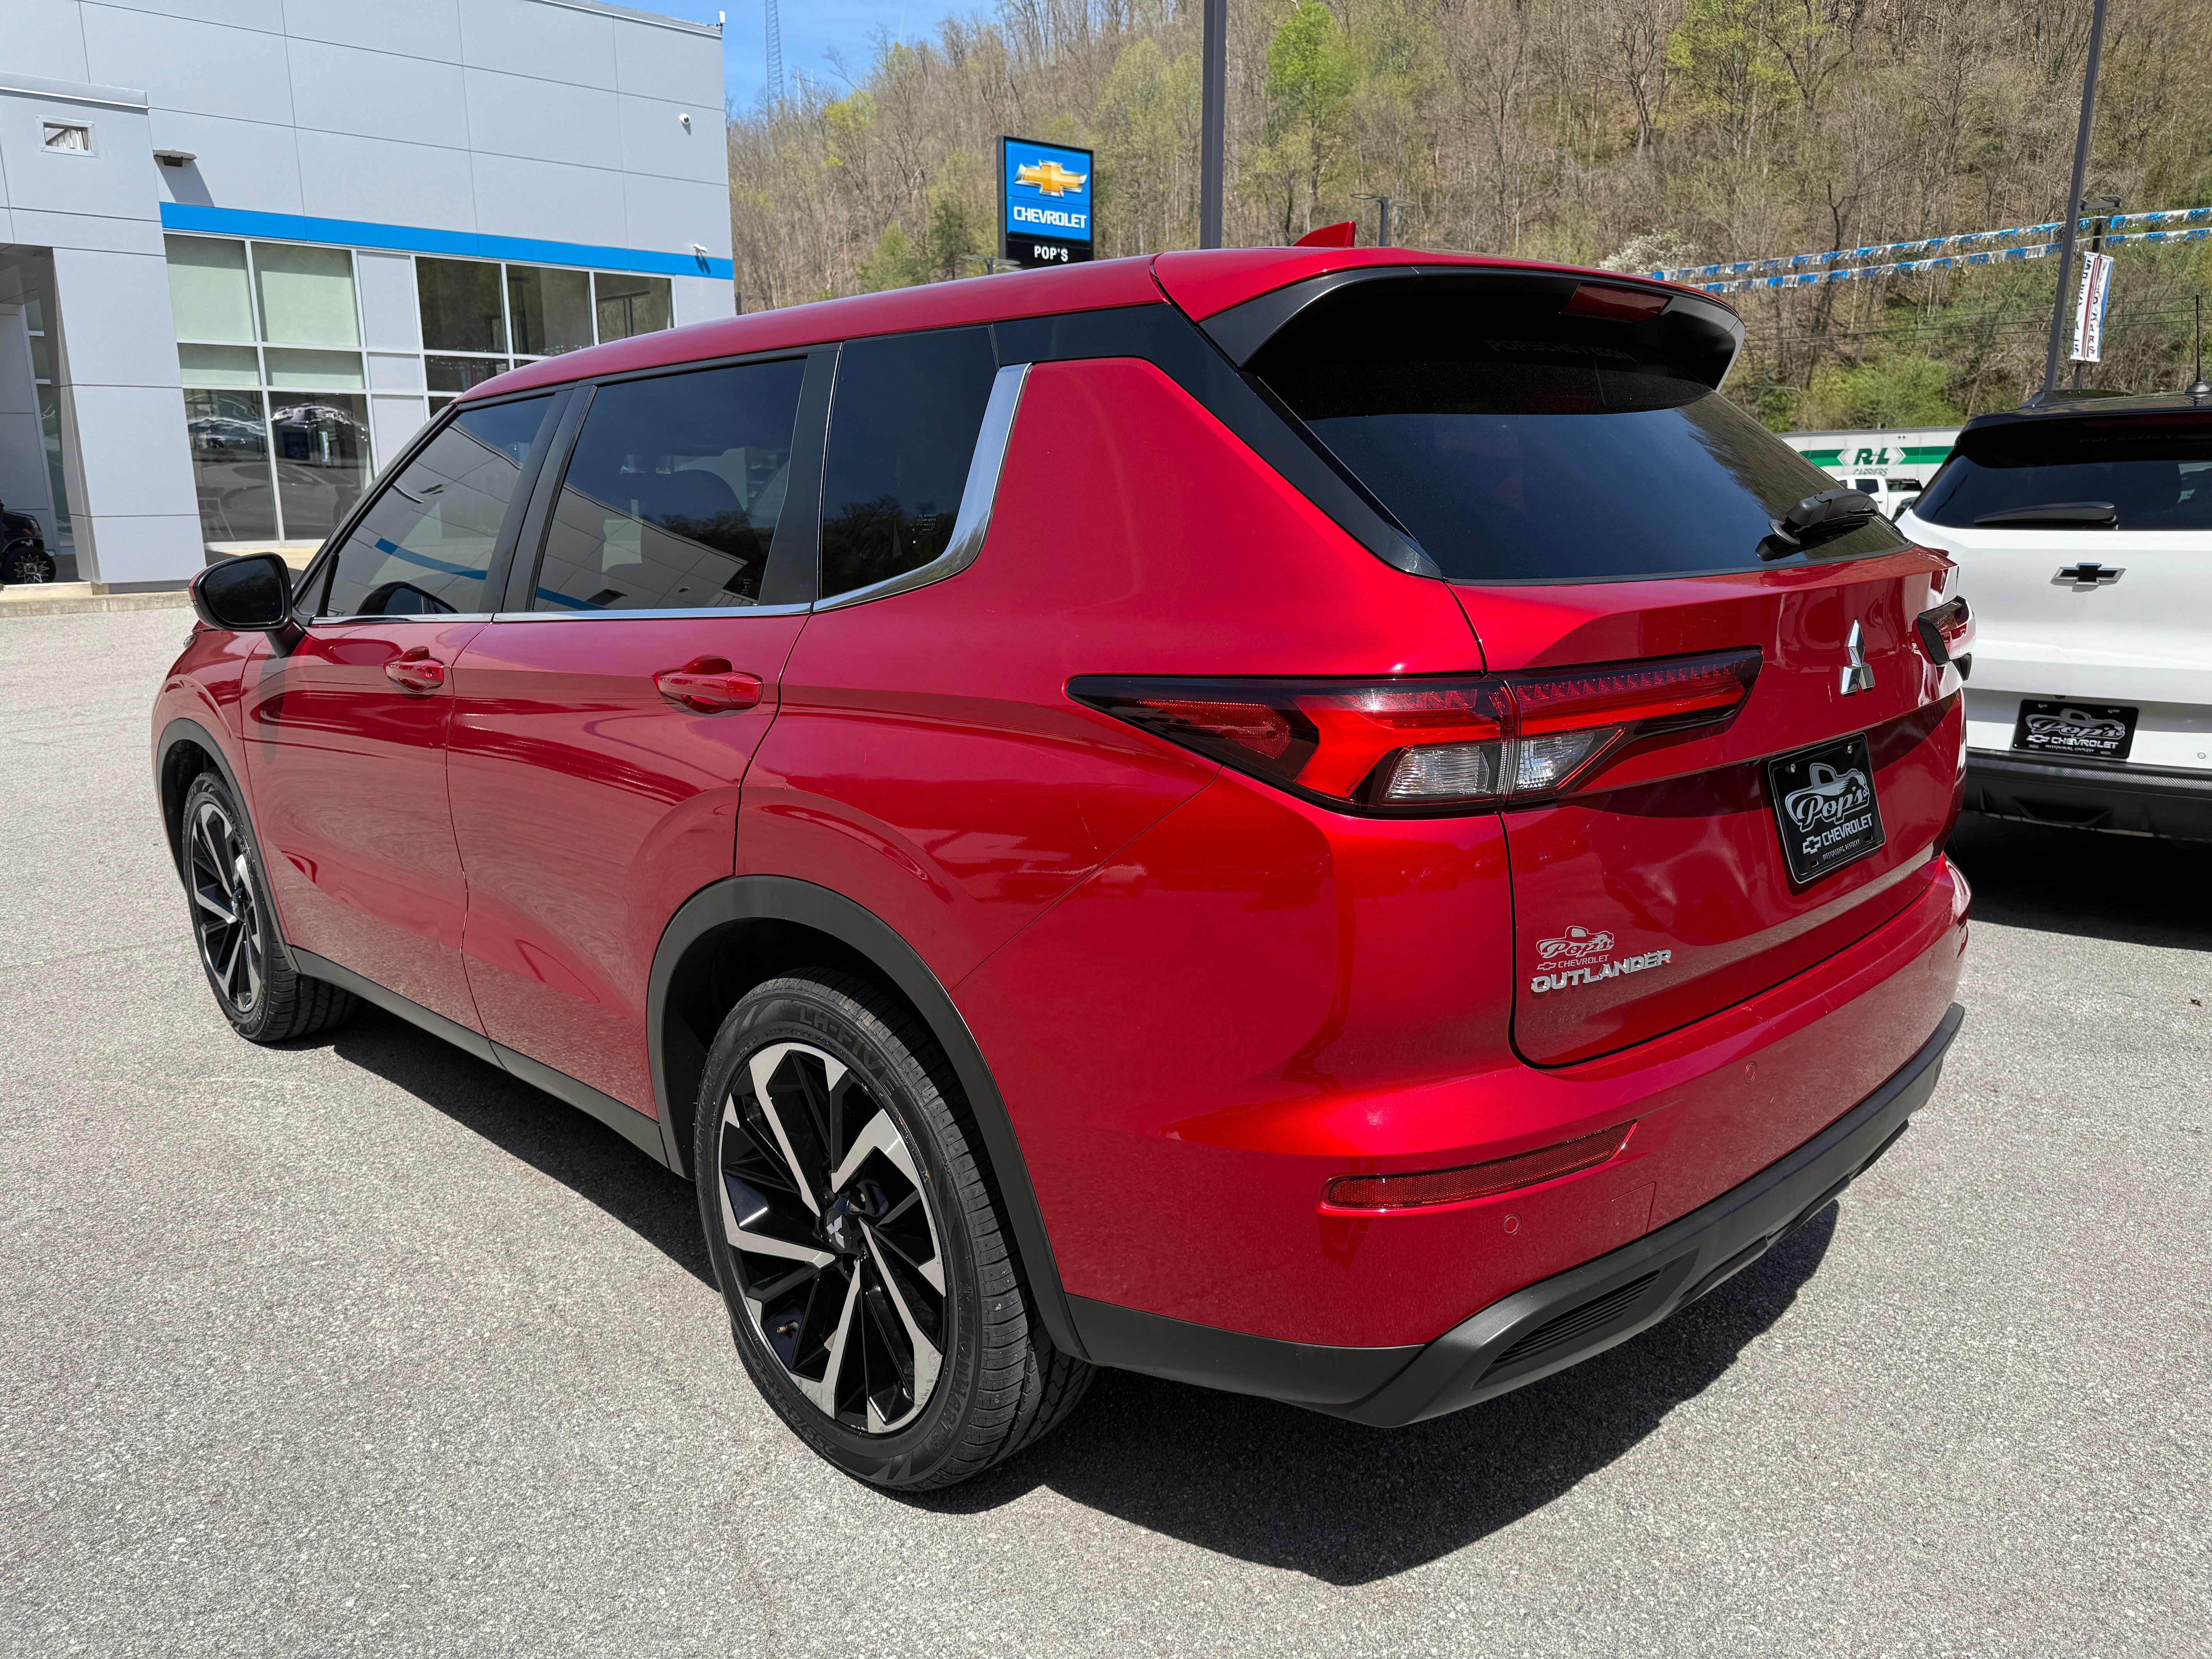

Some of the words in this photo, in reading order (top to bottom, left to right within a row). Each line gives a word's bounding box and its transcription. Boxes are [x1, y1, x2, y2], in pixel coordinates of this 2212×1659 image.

[1013, 206, 1087, 229] CHEVROLET
[1034, 245, 1069, 262] POP'S
[2051, 737, 2119, 749] CHEVROLET
[1796, 786, 1867, 825] Pop's
[1822, 813, 1872, 846] CHEVROLET
[1531, 949, 1671, 993] OUTLANDER
[1558, 954, 1609, 969] CHEVROLET
[799, 1005, 900, 1096] LH-FIVE
[941, 1309, 974, 1437] LIONHART
